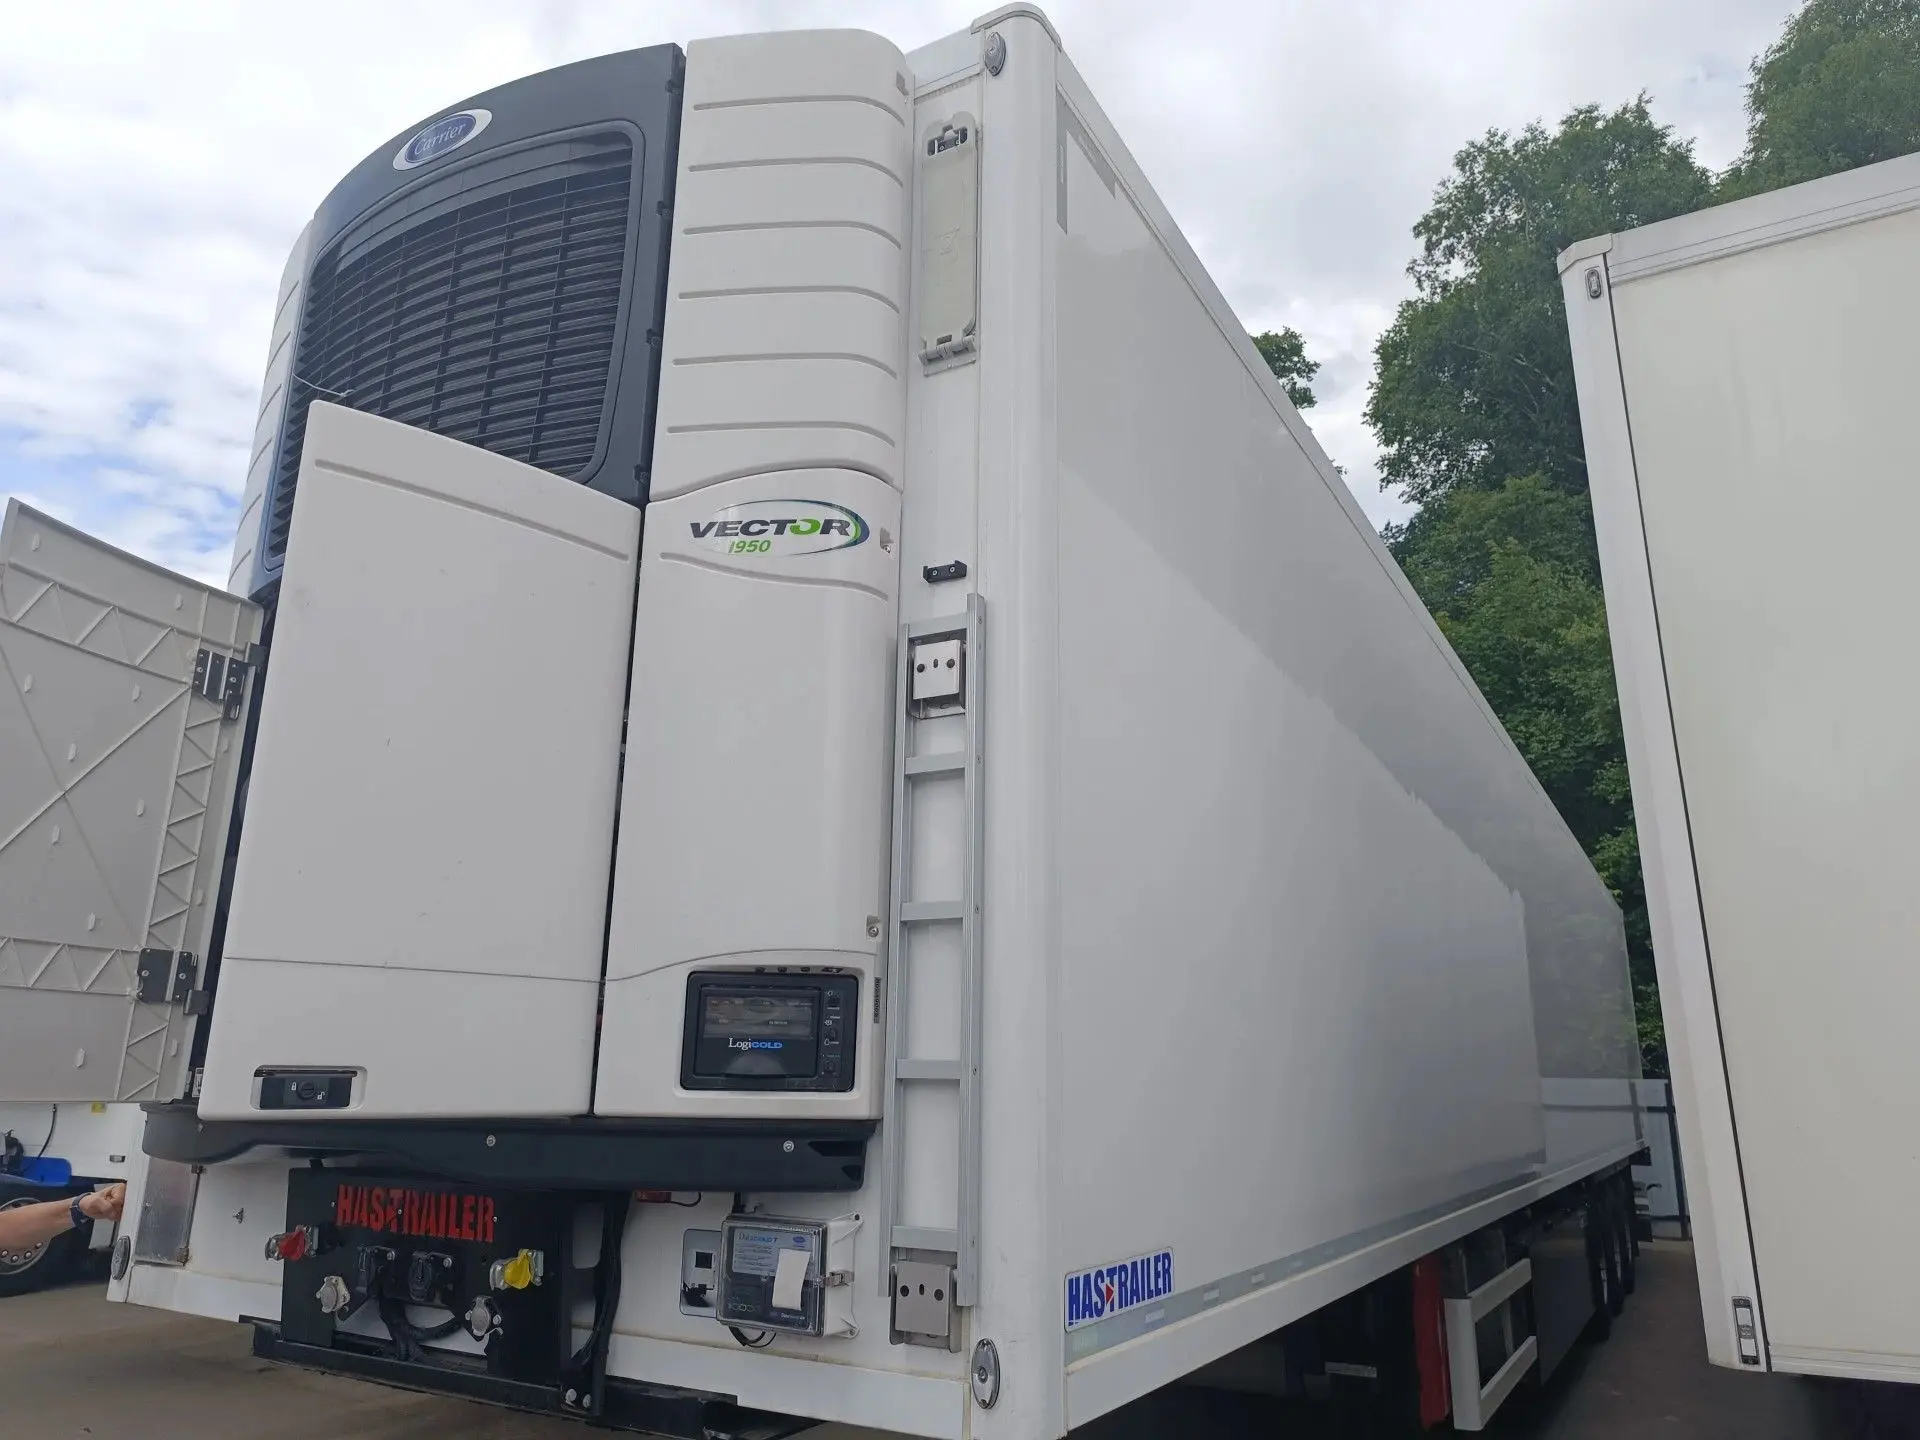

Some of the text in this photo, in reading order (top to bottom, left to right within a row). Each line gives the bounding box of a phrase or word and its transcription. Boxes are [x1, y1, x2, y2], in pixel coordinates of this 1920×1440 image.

[414, 122, 466, 155] Carrier
[690, 518, 851, 538] VECTOR
[728, 539, 771, 553] 1950
[728, 1037, 783, 1051] LogiCOLD
[336, 1184, 495, 1243] HASTRAILER
[1068, 1252, 1172, 1321] HASTRAILER
